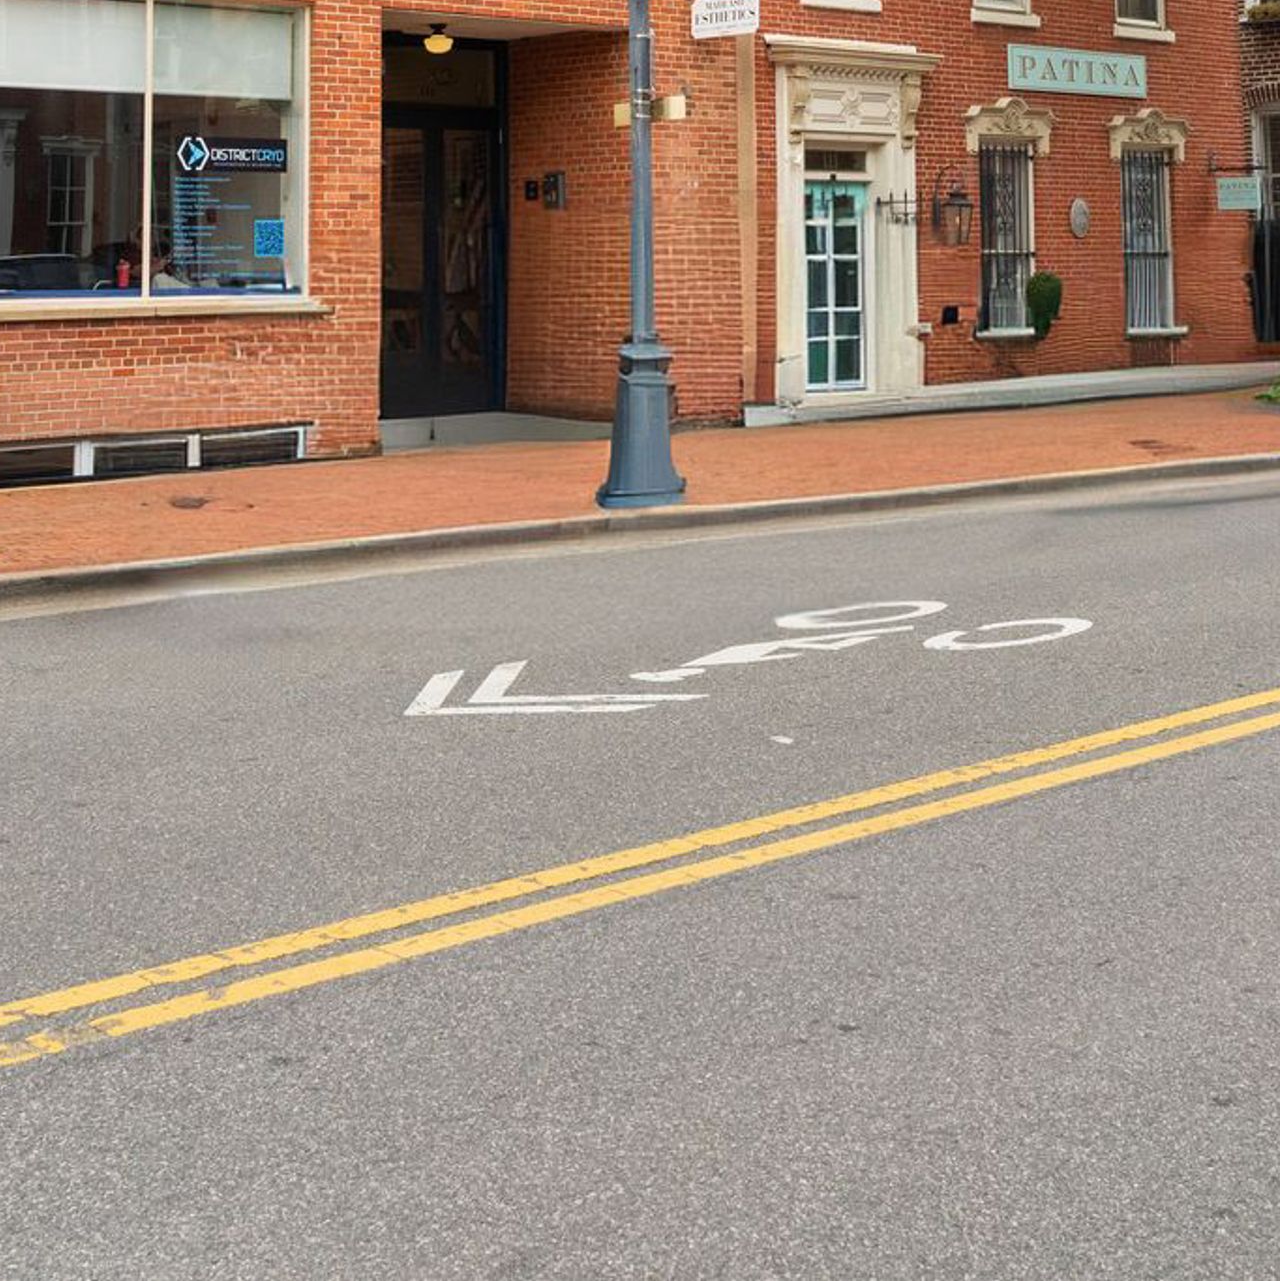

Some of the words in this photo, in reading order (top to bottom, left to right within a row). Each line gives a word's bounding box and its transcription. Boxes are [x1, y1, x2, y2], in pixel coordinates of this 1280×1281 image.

[694, 9, 756, 26] ESTHETICS
[1016, 54, 1140, 87] PATINA
[210, 148, 284, 162] DISTRICTCRYO
